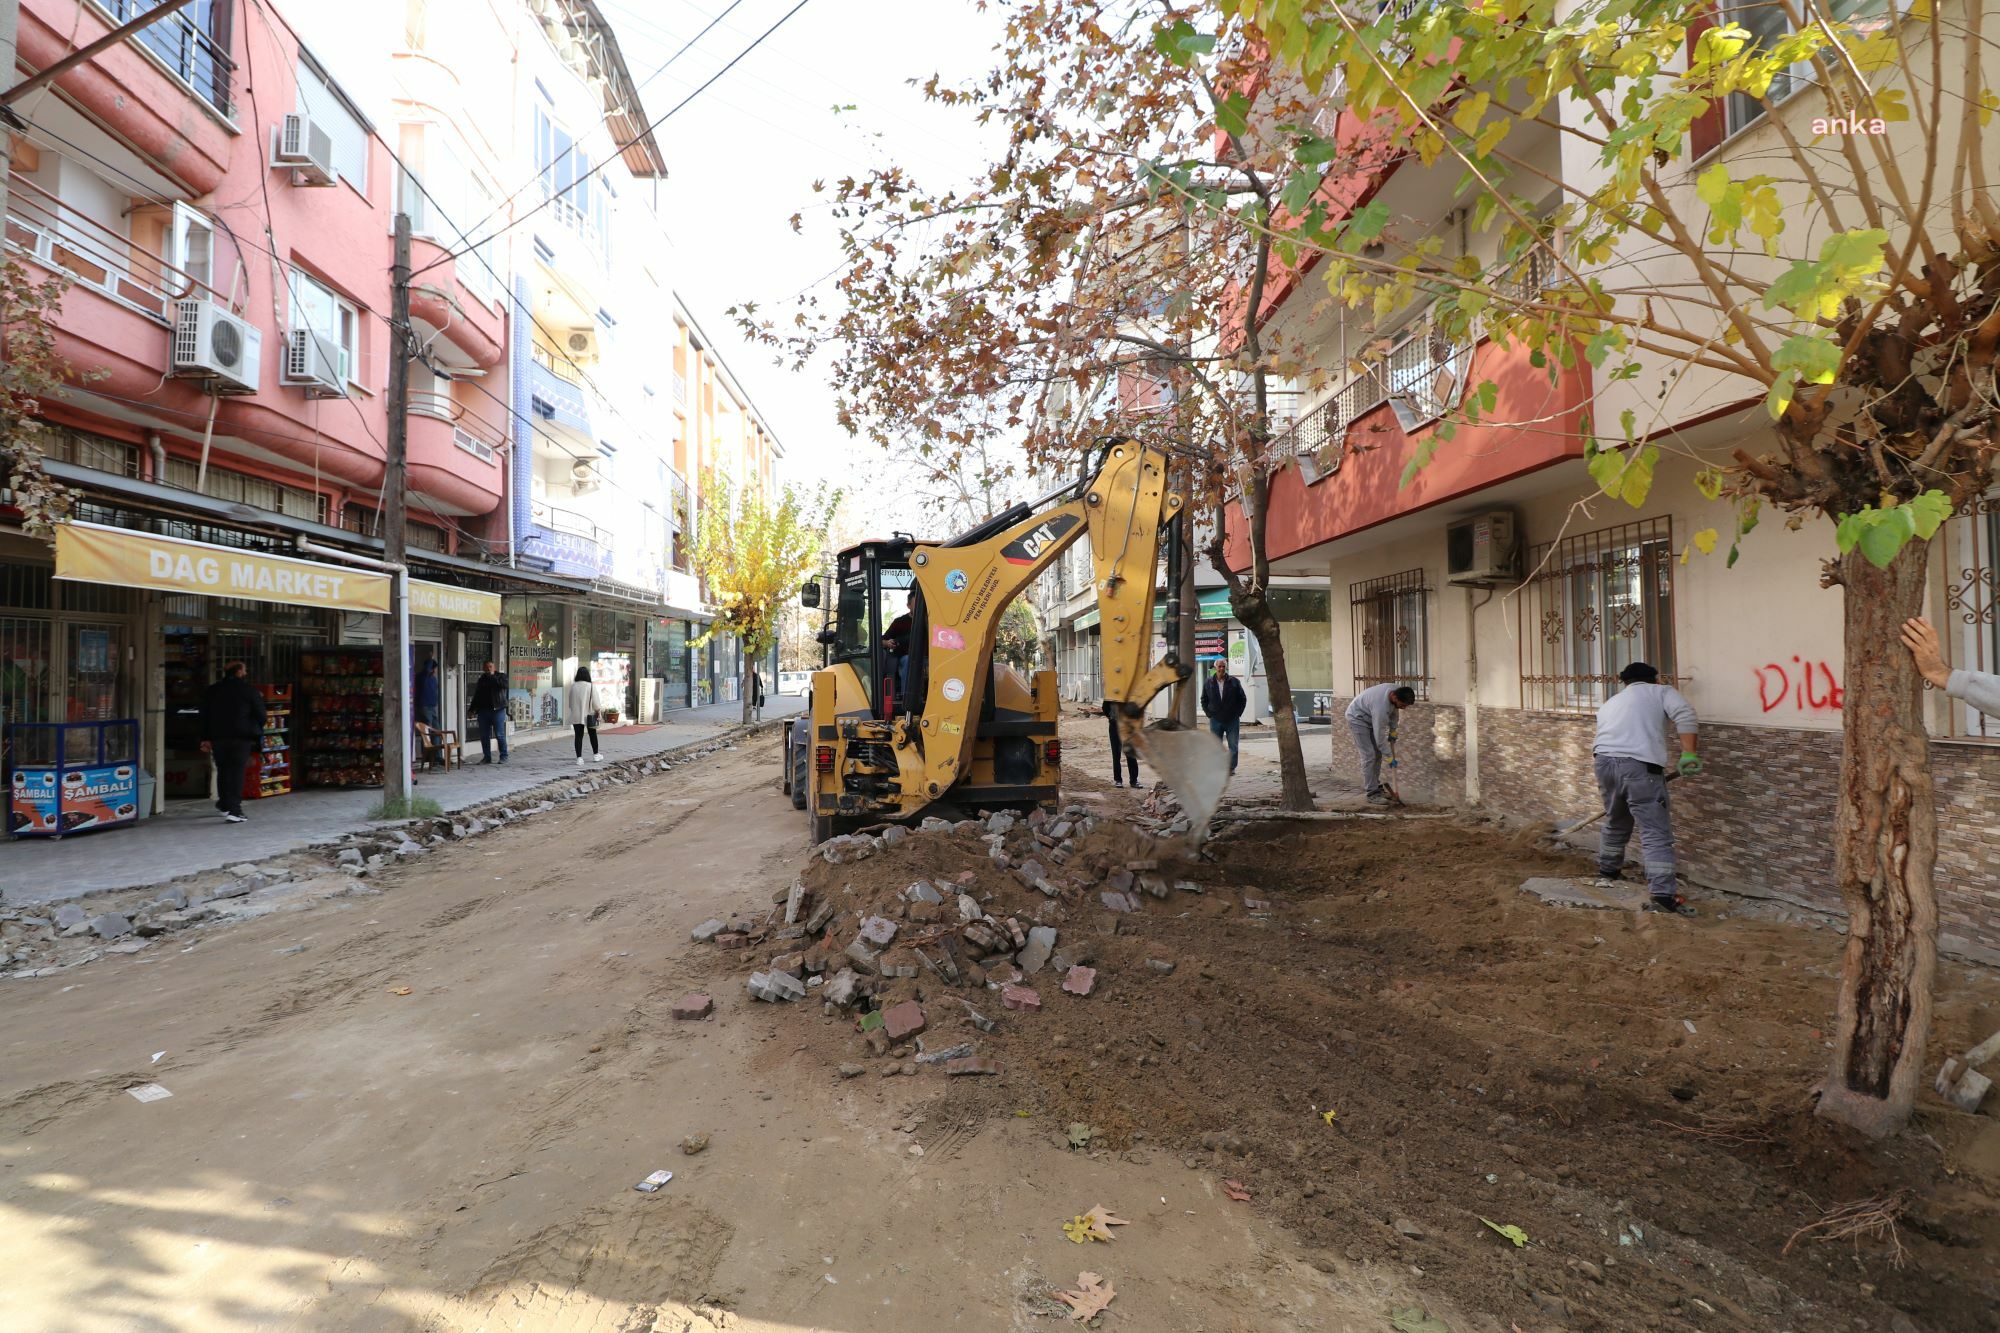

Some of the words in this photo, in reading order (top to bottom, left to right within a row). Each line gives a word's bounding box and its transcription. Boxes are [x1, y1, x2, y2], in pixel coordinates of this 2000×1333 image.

[1023, 523, 1056, 558] CAT
[150, 550, 220, 585] DAG
[231, 562, 344, 600] MARKET
[412, 588, 436, 608] DAG
[439, 594, 481, 616] MARKET
[64, 780, 133, 801] ŞAMBALİ
